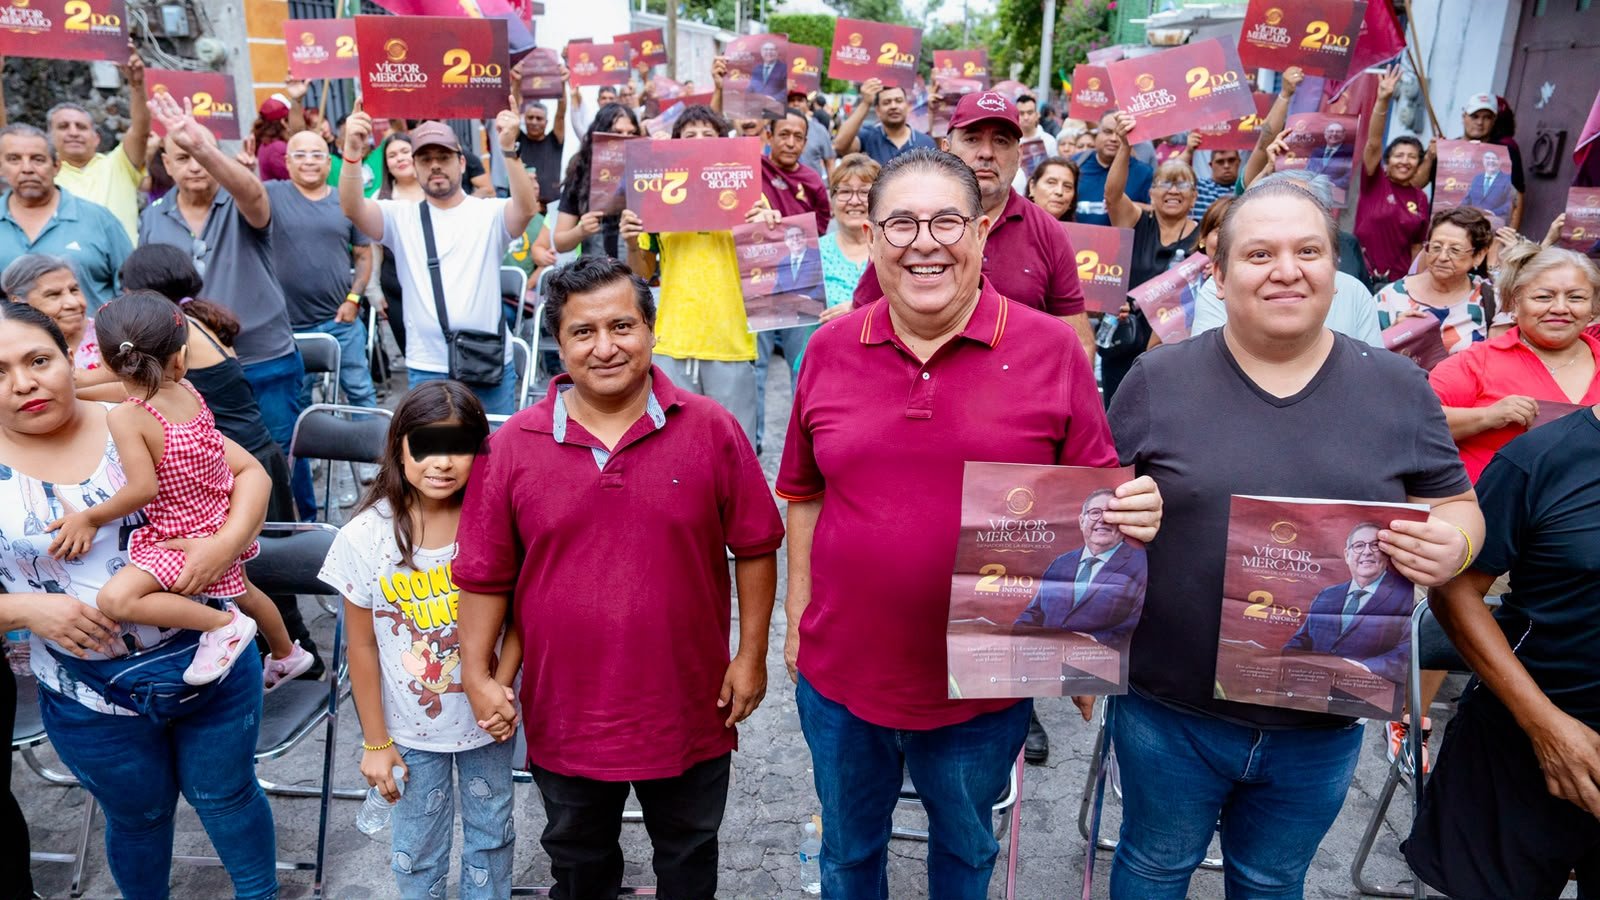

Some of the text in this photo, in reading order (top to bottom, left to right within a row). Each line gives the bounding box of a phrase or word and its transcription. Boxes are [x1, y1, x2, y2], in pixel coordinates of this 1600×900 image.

[64, 0, 121, 31] 2DO
[1246, 30, 1291, 44] MERCADO
[1254, 23, 1288, 36] VÍCTOR
[1300, 20, 1351, 49] 2DO
[877, 43, 915, 65] 2DO
[375, 61, 419, 74] VÍCTOR
[442, 48, 502, 84] 2DO
[369, 72, 428, 83] MERCADO
[1185, 66, 1238, 99] 2DO
[192, 92, 234, 116] 2DO
[1127, 94, 1177, 114] MERCADO
[1130, 88, 1169, 103] VÍCTOR
[701, 170, 754, 180] MERCADO
[708, 179, 748, 190] VÍCTOR
[633, 171, 689, 205] 2DO
[1075, 250, 1123, 280] 2DO
[989, 516, 1047, 531] VÍCTOR
[976, 531, 1056, 543] MERCADO
[1253, 544, 1312, 562] VÍCTOR
[1242, 555, 1321, 573] MERCADO
[379, 563, 460, 604] LOON
[975, 563, 1034, 592] 2DO
[1002, 586, 1033, 594] INFORME
[400, 592, 460, 631] TUNE
[1243, 590, 1302, 619] 2DO
[1269, 614, 1301, 623] INFORME
